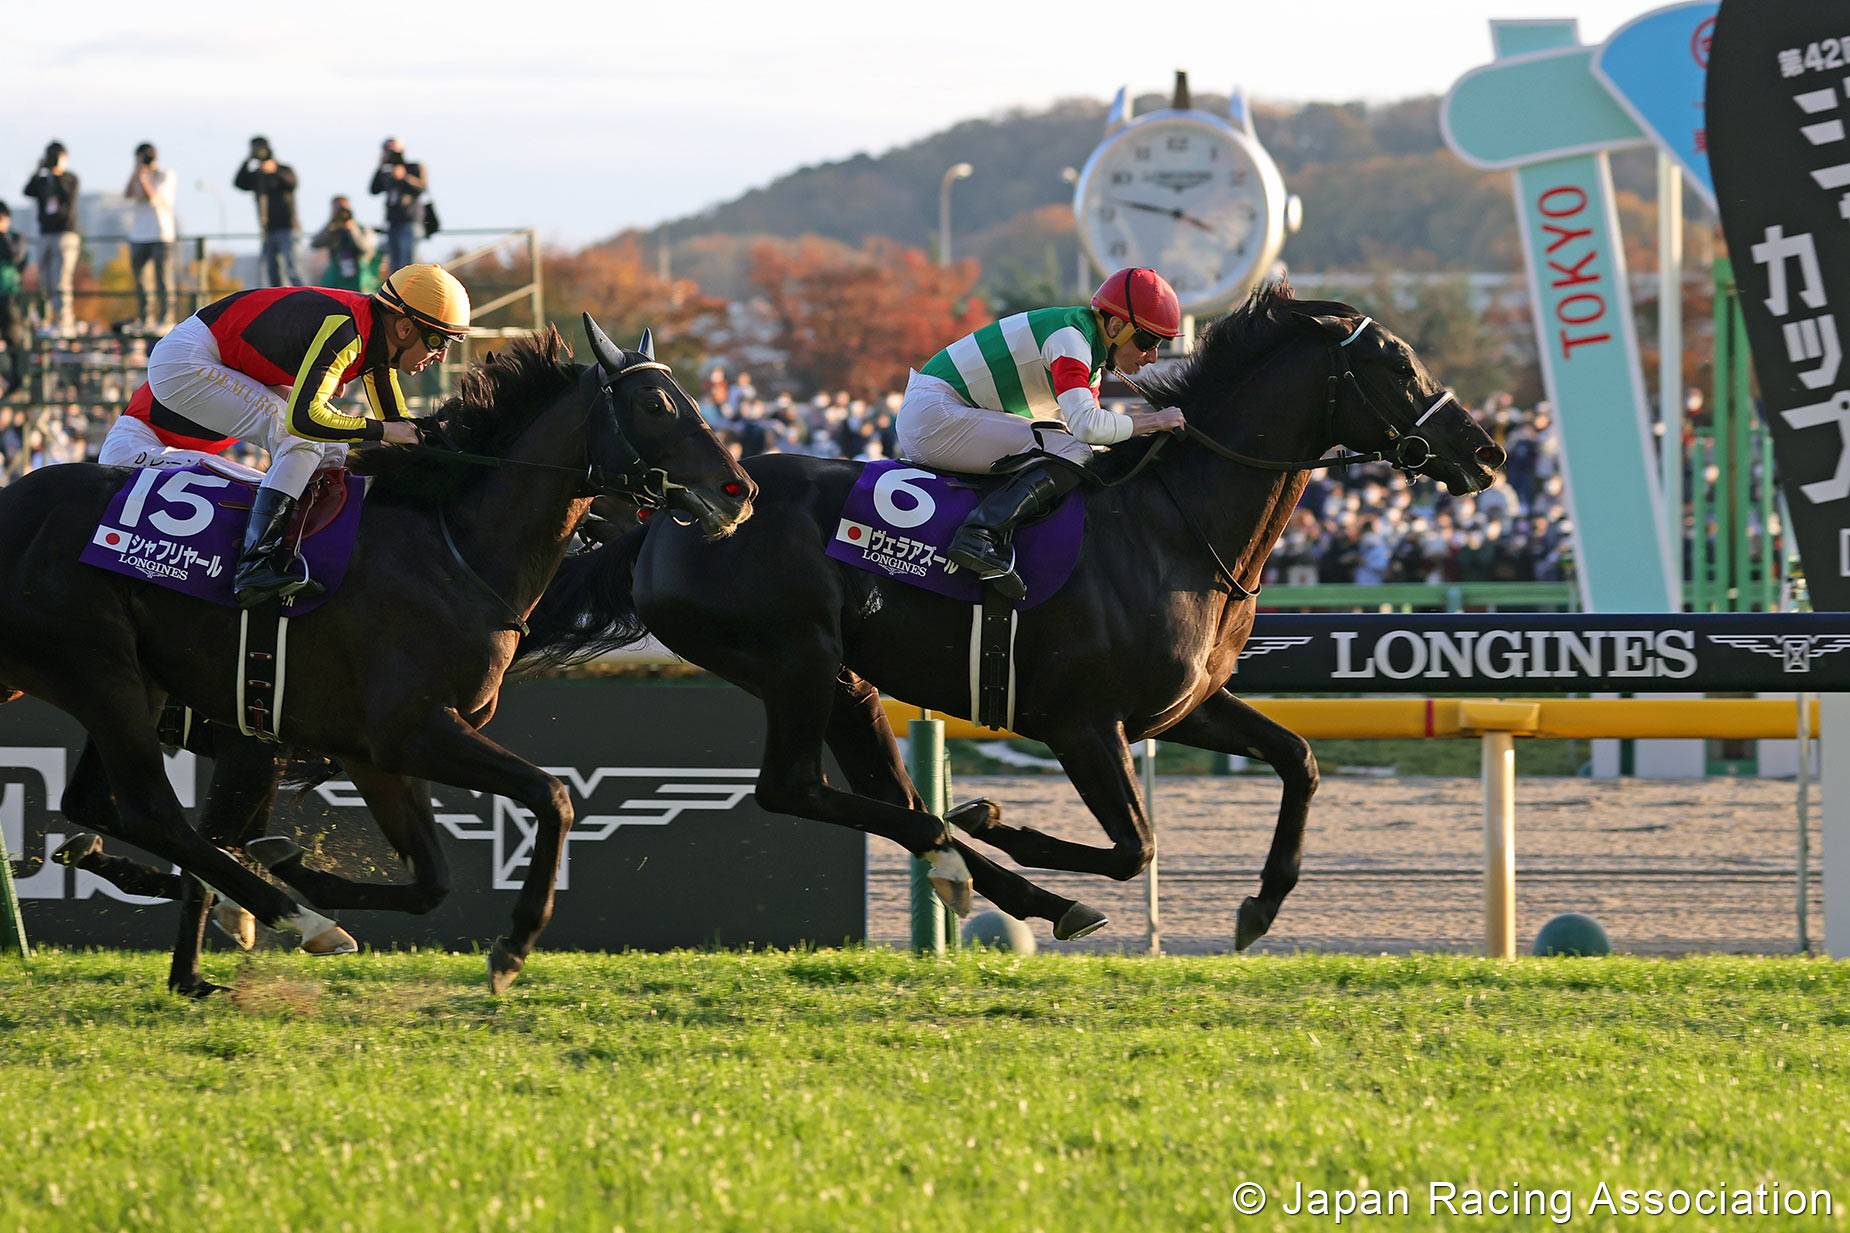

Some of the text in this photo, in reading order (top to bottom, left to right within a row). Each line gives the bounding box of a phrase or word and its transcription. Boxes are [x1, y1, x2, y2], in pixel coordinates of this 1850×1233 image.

[1537, 184, 1612, 360] TOKYO
[119, 468, 231, 537] 15
[873, 468, 937, 529] 6
[118, 553, 189, 581] LONGINES
[129, 534, 223, 578] シャフリヤール
[862, 548, 928, 577] LONGINES
[1330, 629, 1698, 680] LONGINES
